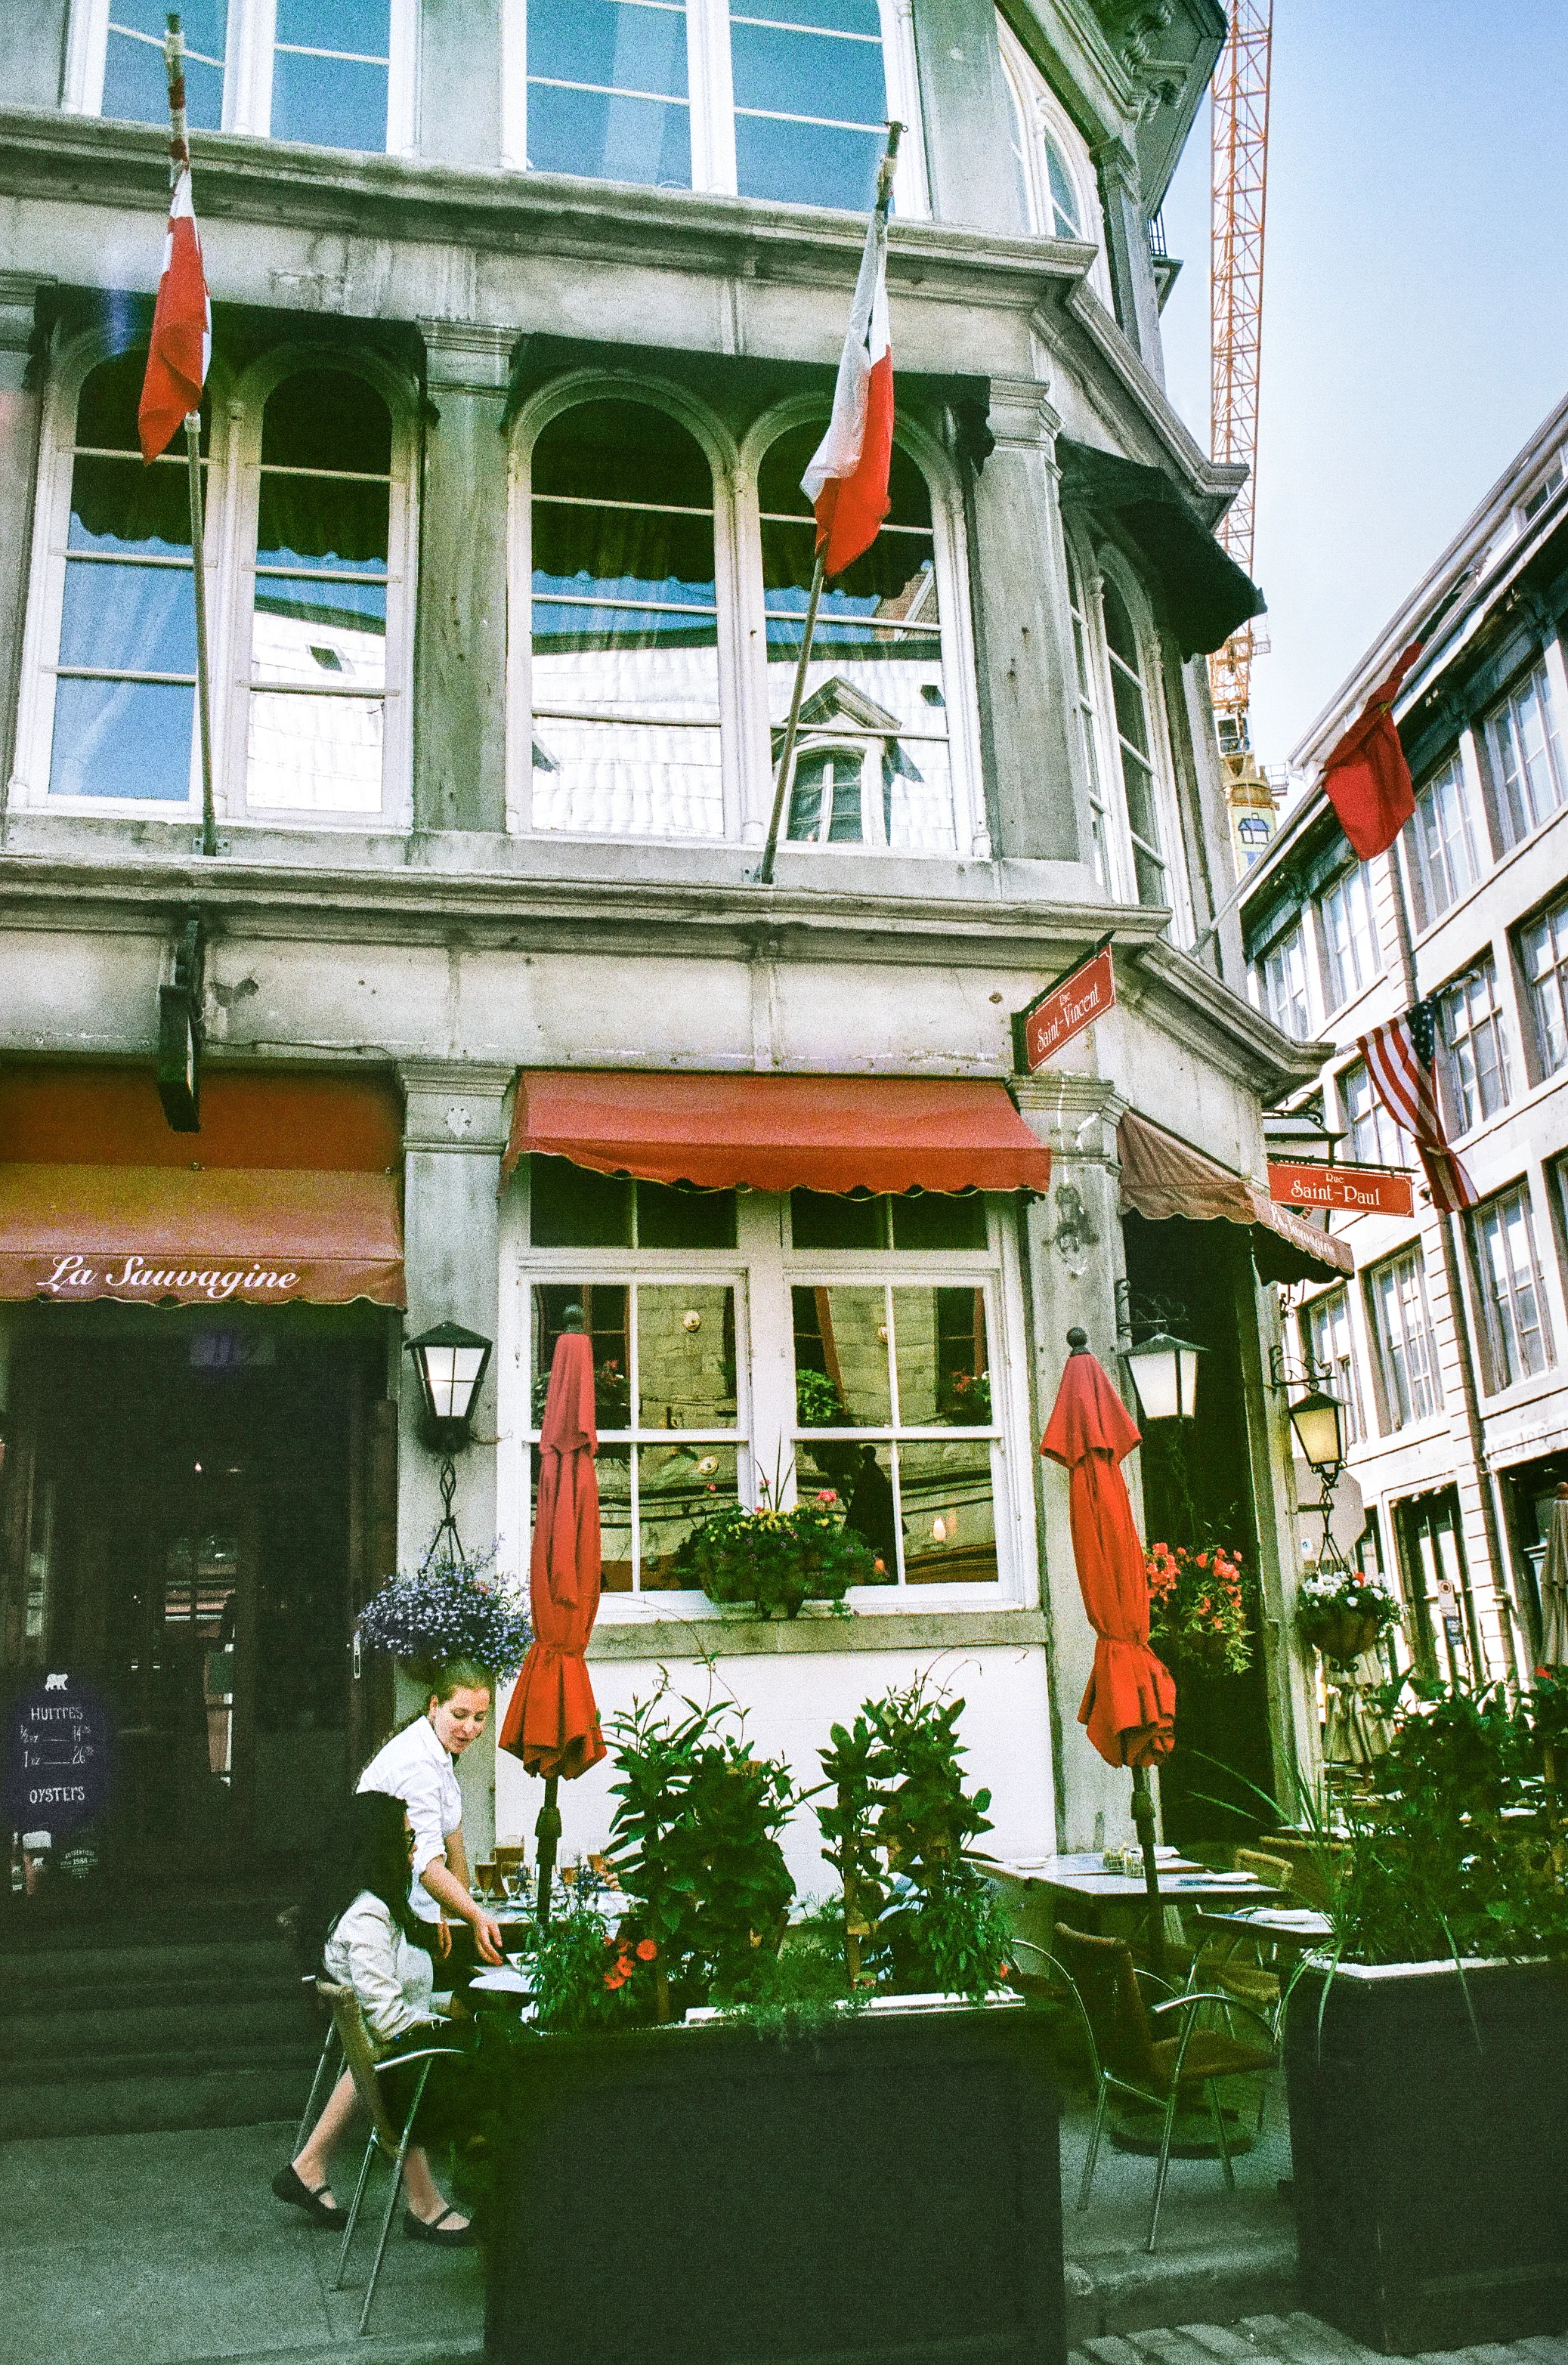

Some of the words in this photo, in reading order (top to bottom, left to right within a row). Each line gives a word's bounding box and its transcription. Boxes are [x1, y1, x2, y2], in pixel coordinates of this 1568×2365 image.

[1037, 982, 1100, 1053] Saint-Vincent
[1290, 1179, 1381, 1206] Saint-Paul
[1325, 1173, 1344, 1184] Rue
[36, 1255, 97, 1292] La
[106, 1256, 301, 1299] Sauvagine
